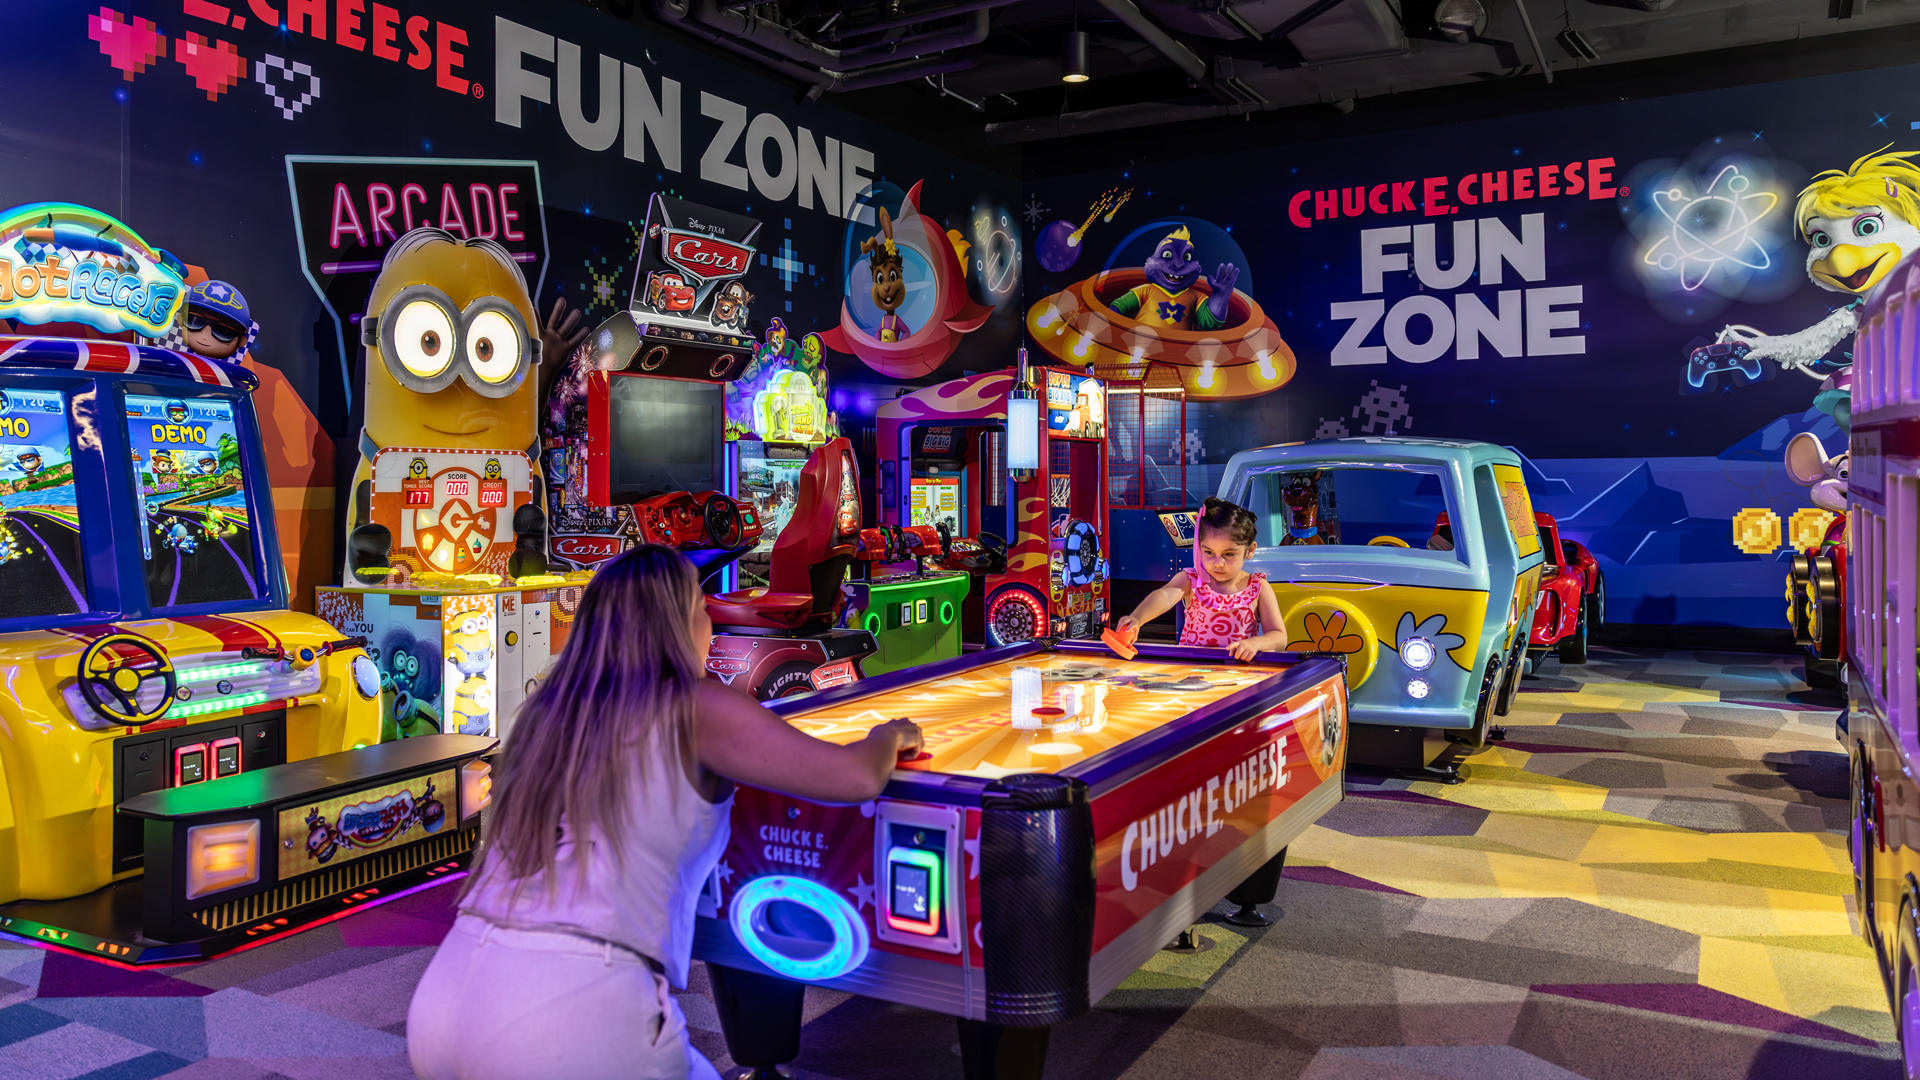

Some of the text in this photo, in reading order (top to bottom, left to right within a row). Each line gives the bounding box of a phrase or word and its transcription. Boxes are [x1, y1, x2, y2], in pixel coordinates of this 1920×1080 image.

[495, 15, 876, 227] FUN ZONE
[1288, 180, 1417, 228] CHUCK
[329, 182, 525, 249] ARCADE
[673, 239, 739, 271] Cars
[1361, 212, 1546, 294] FUN
[70, 259, 177, 325] Racers
[1330, 285, 1587, 366] ZONE
[1048, 371, 1071, 388] SUPER
[22, 396, 44, 407] 120
[1048, 388, 1060, 401] BIG
[200, 407, 217, 417] 120
[794, 414, 813, 425] LAND
[151, 423, 206, 444] DEMO
[409, 491, 430, 504] 177
[446, 482, 468, 495] 000
[482, 491, 503, 503] 000
[556, 538, 614, 556] Cars
[502, 598, 515, 612] ME
[354, 622, 374, 634] YOU
[709, 660, 744, 671] Cars
[343, 798, 409, 831] Hot Racers
[759, 825, 811, 847] CHUCK
[1121, 786, 1203, 891] CHUCK
[763, 844, 821, 868] CHEESE
